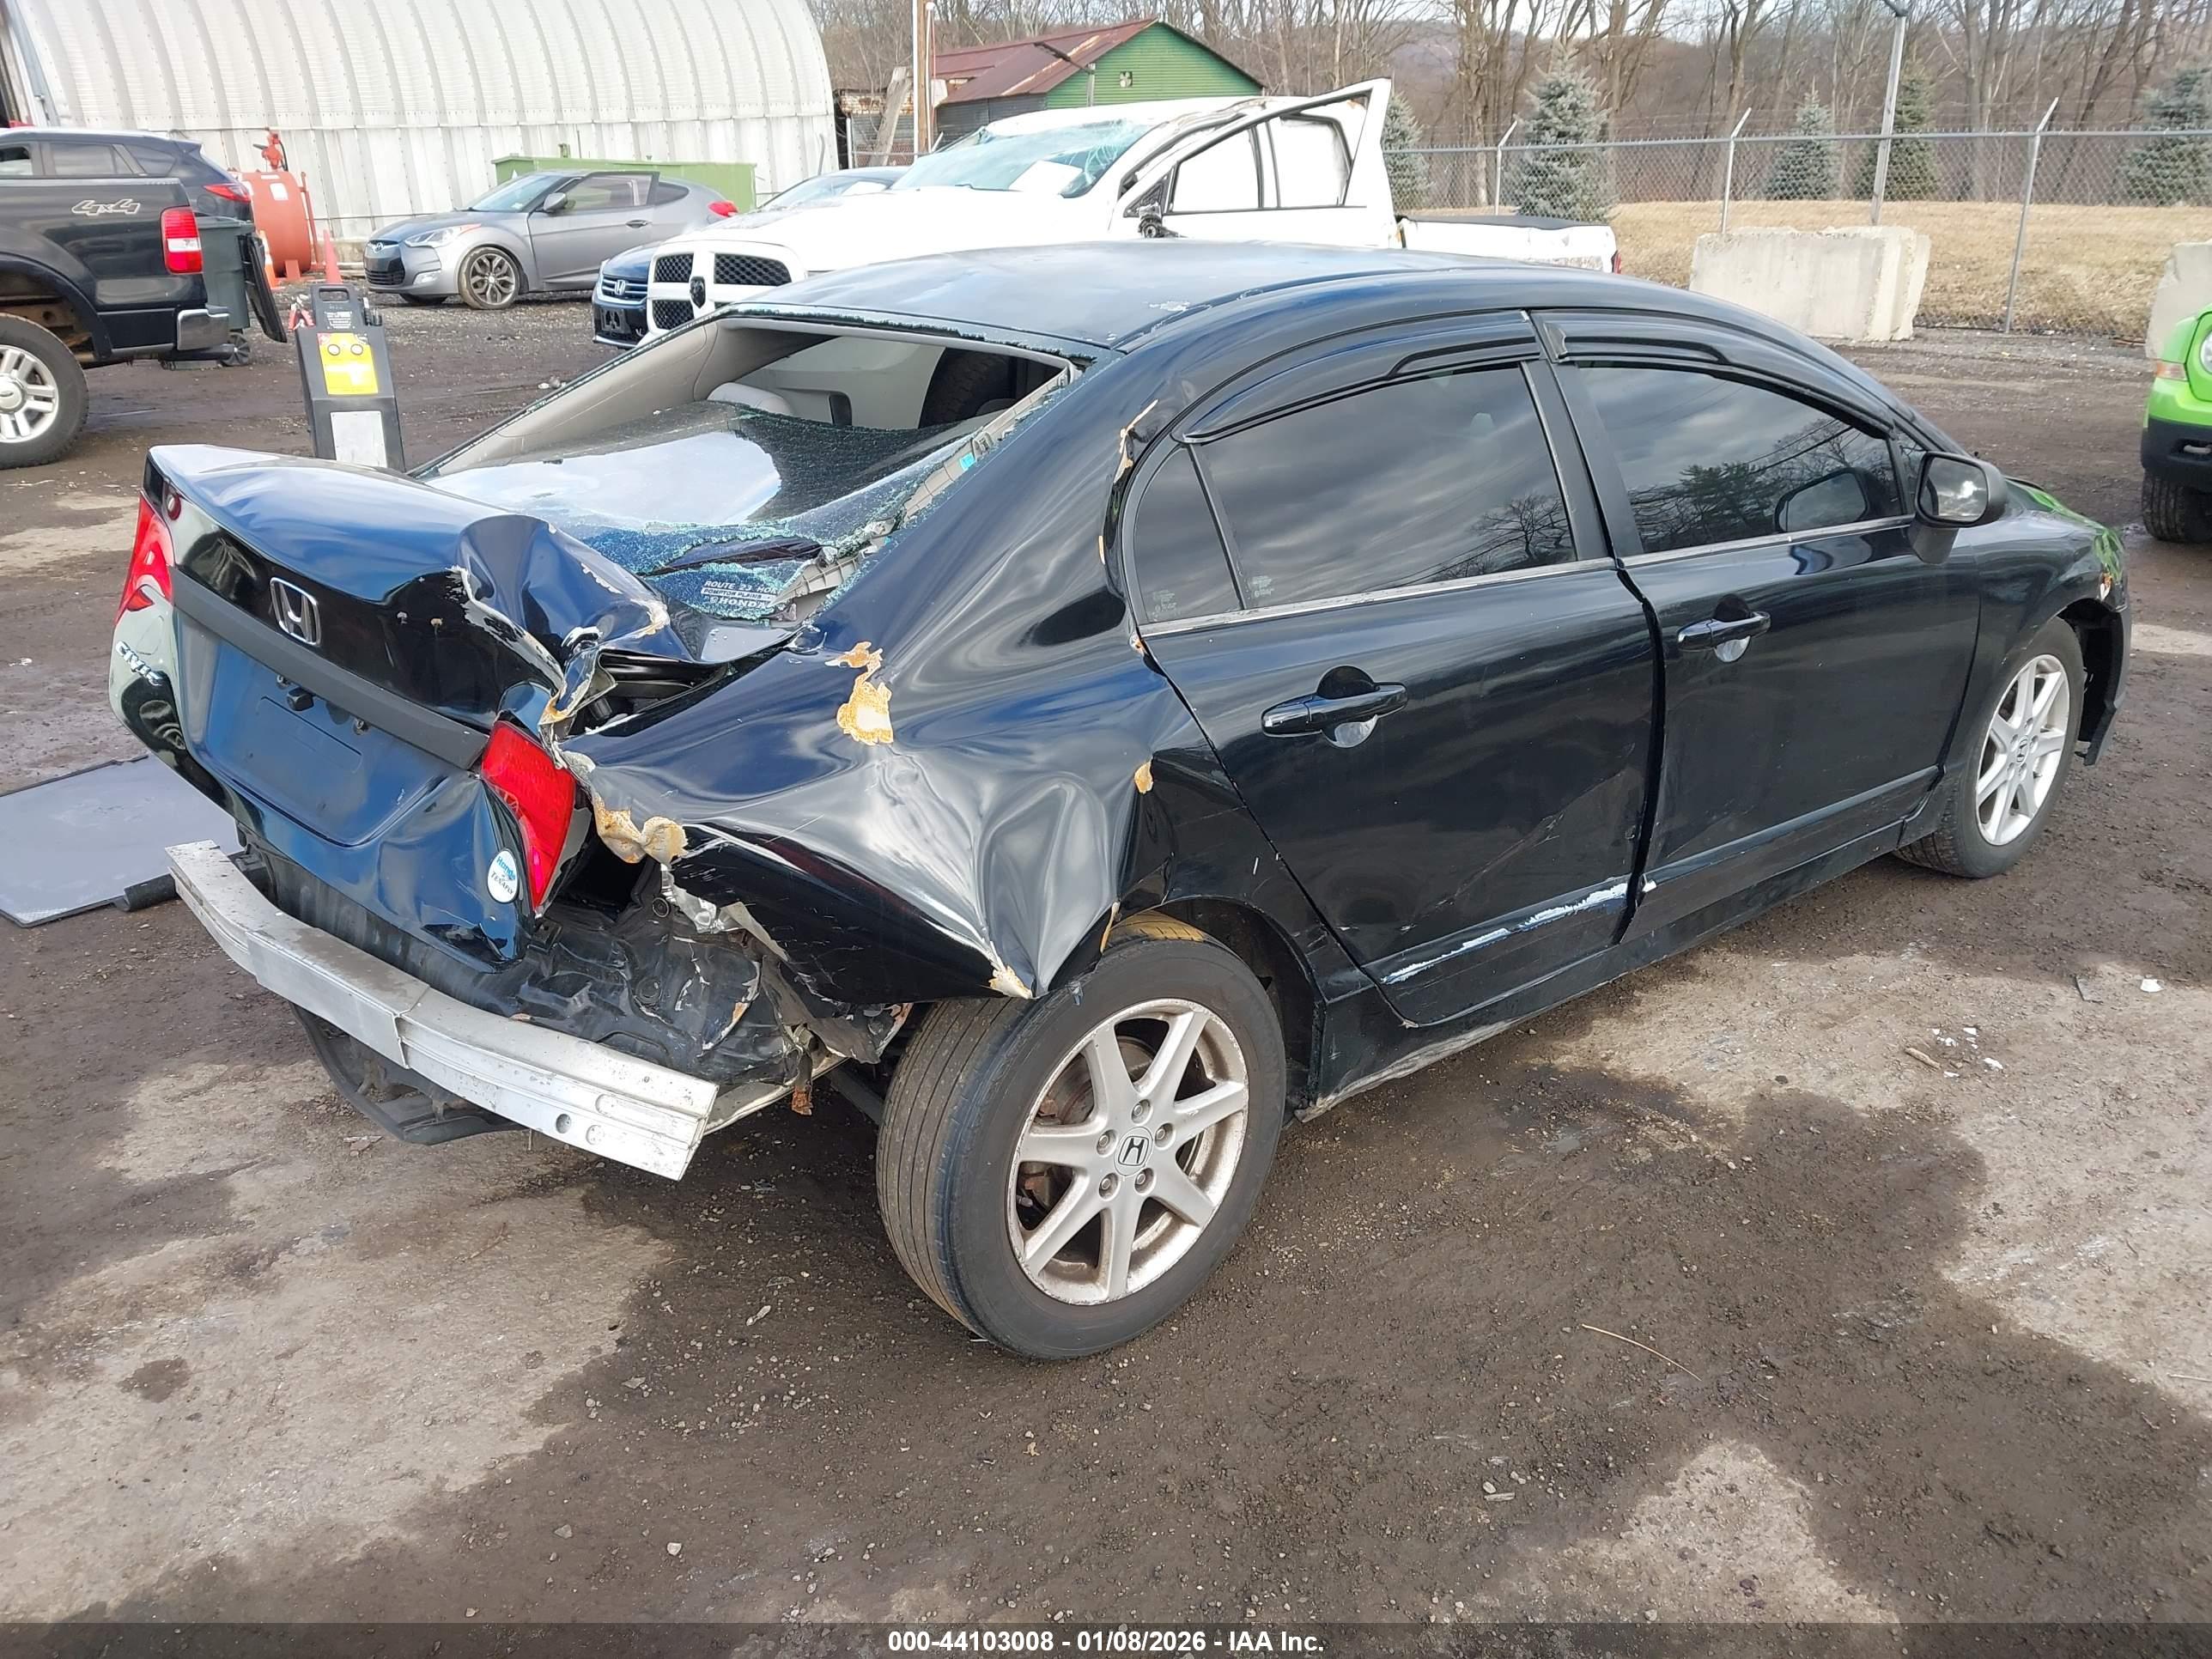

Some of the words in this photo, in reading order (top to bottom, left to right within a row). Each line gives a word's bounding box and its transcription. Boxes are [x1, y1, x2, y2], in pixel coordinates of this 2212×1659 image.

[704, 580, 736, 589] ROUTE
[757, 584, 779, 594] HON
[718, 596, 767, 608] HONDA
